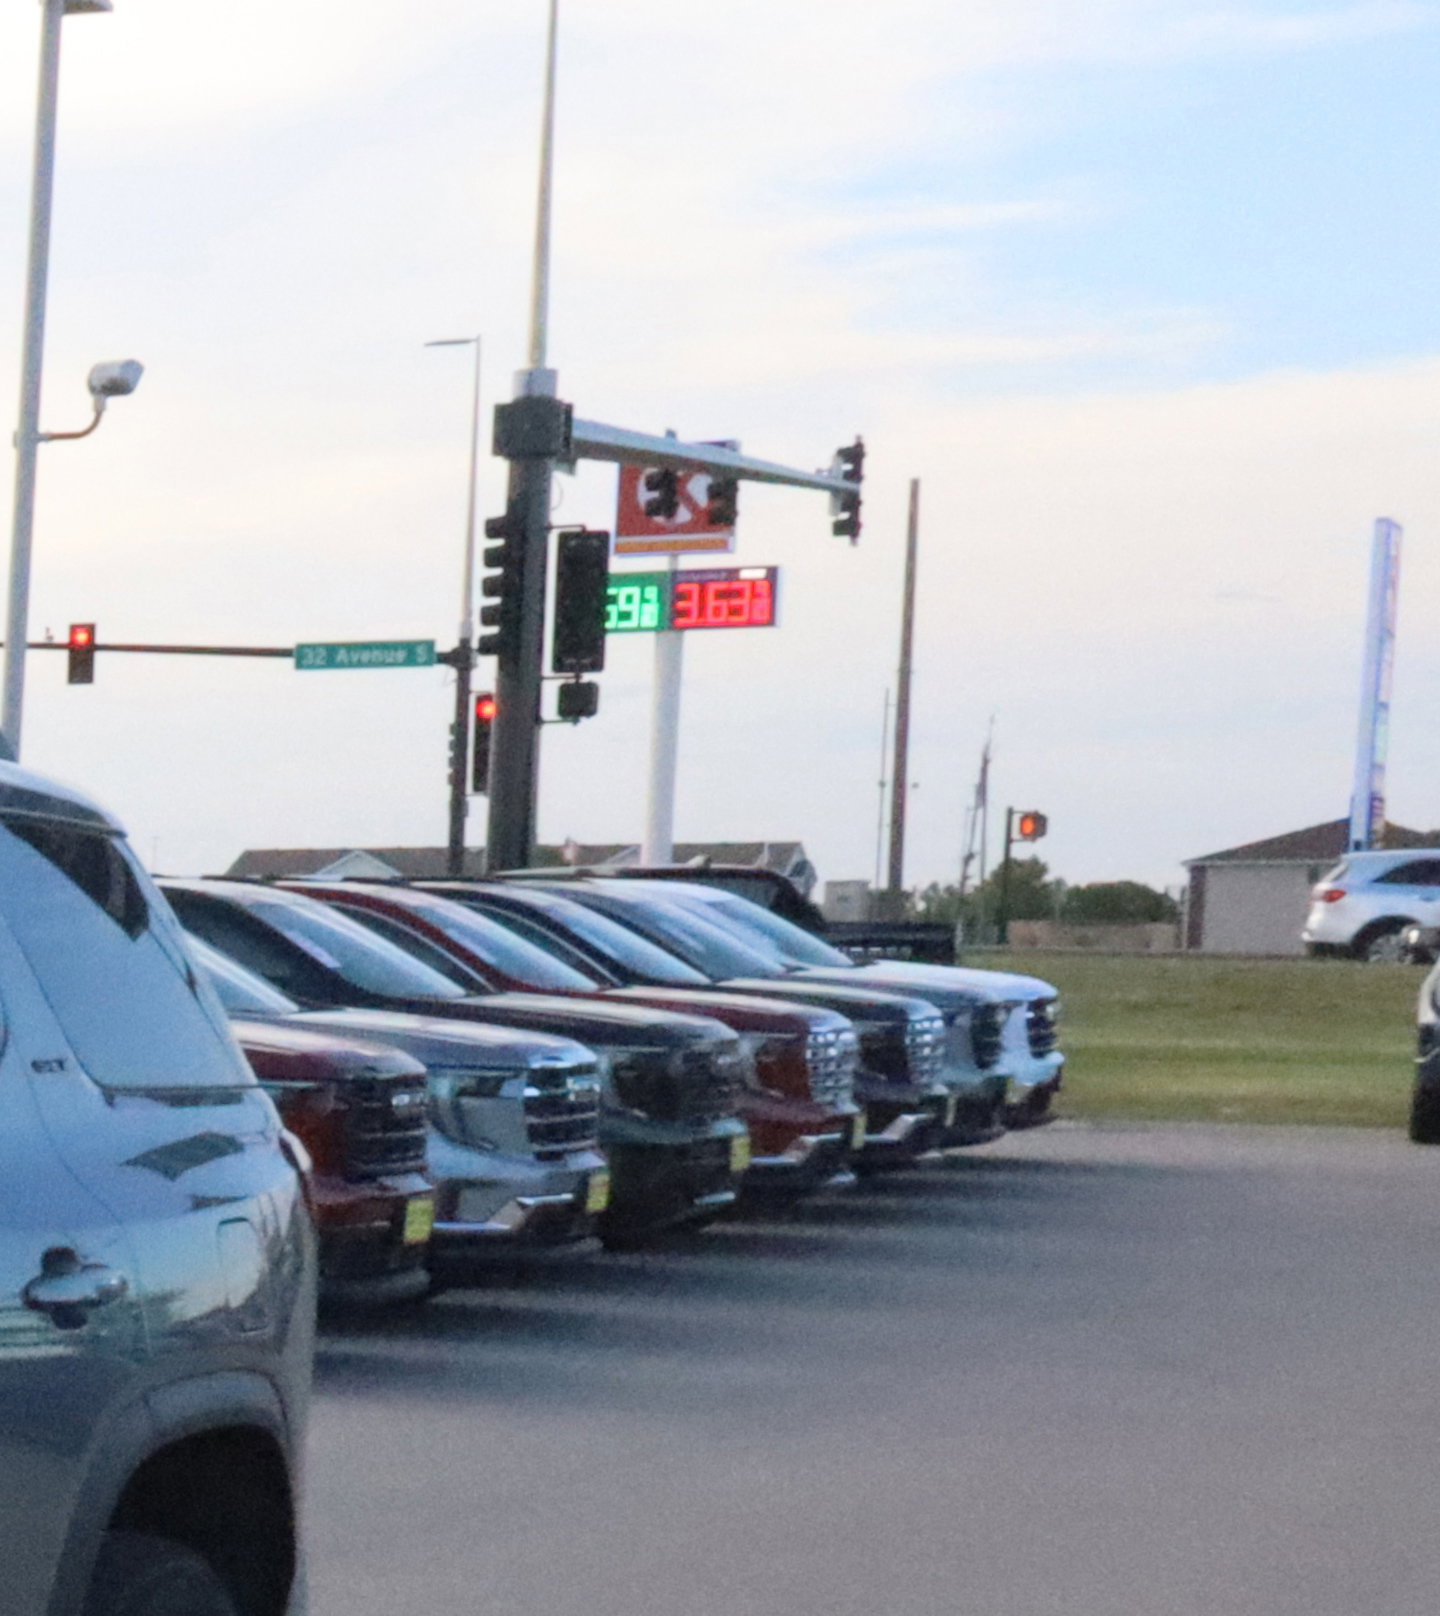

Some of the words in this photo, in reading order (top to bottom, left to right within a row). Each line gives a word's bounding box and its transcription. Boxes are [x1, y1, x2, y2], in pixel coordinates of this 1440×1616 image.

[302, 646, 327, 666] 32
[335, 647, 408, 665] Avenue
[415, 643, 428, 663] S
